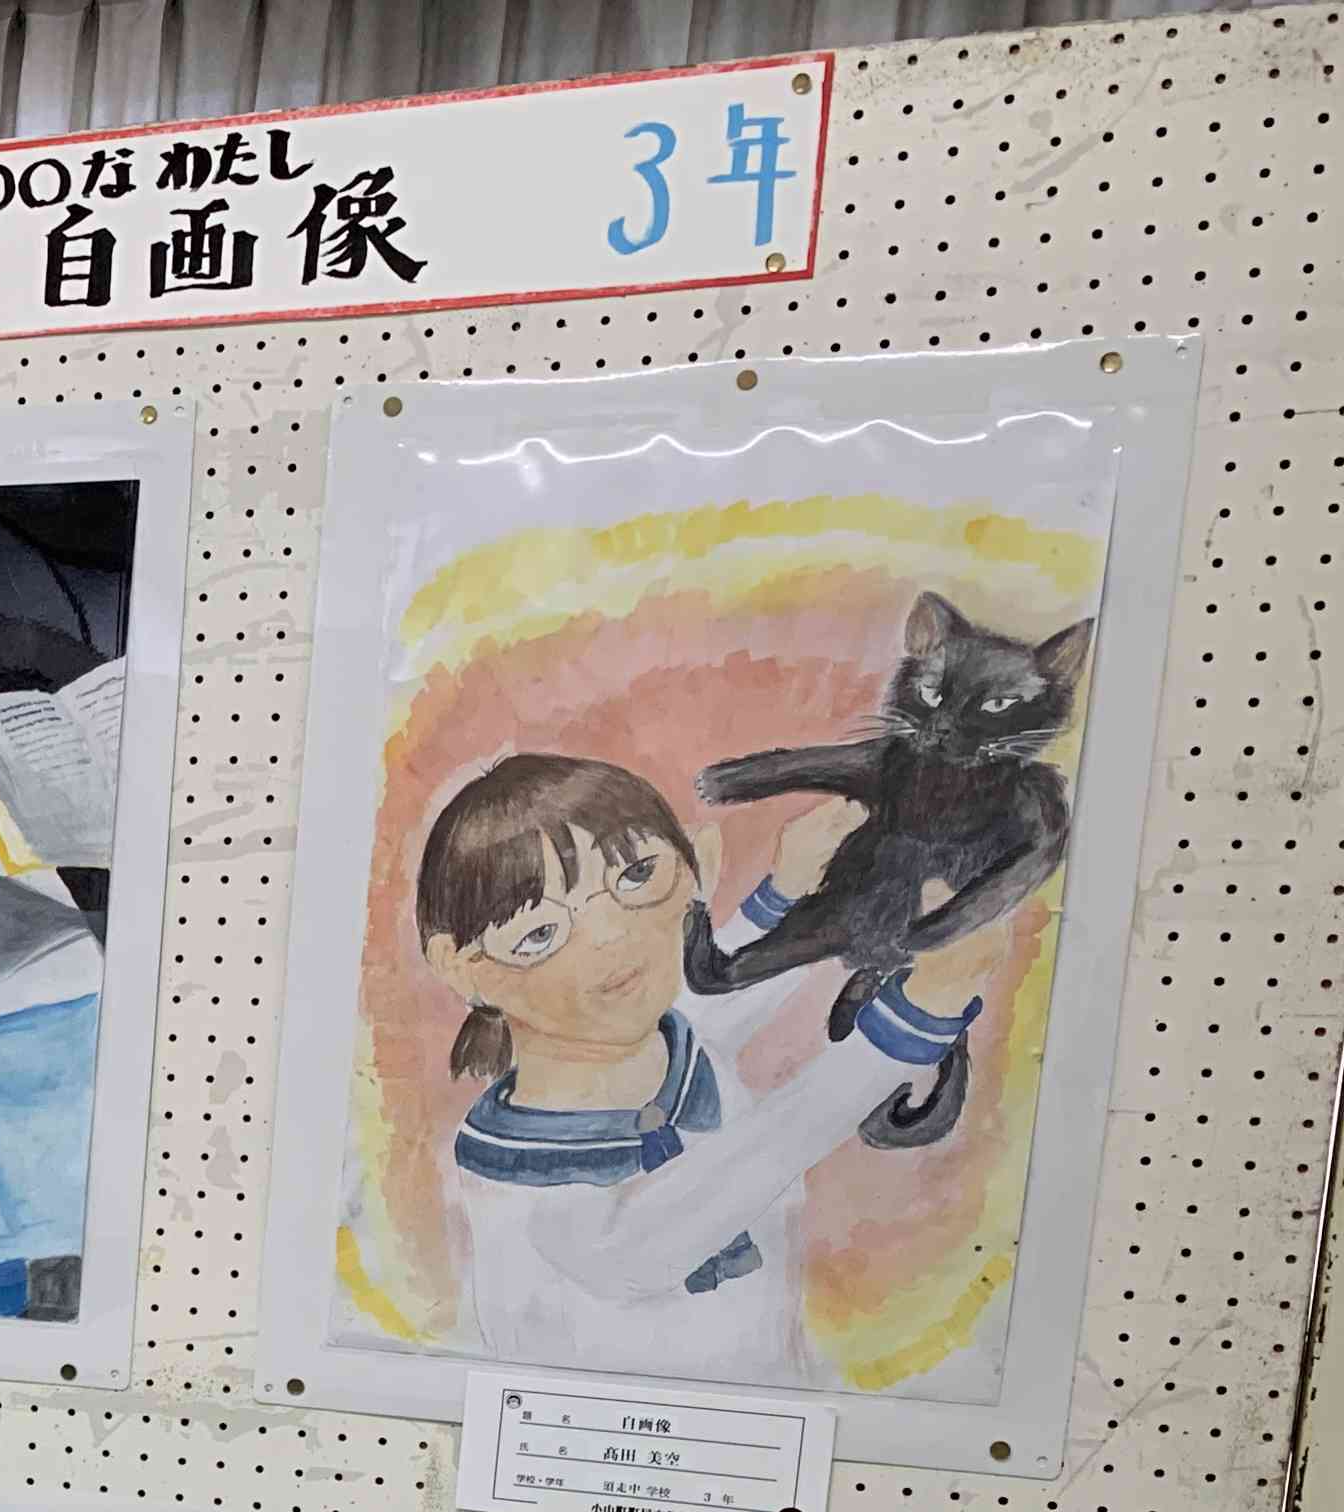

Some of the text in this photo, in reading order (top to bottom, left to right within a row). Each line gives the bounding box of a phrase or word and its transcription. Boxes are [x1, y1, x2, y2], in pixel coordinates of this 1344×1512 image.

[43, 103, 798, 307] 自画像 3年
[622, 1415, 672, 1434] 自画像
[648, 1450, 680, 1467] 美空
[646, 1485, 671, 1499] 学校
[703, 1492, 711, 1502] 3
[723, 1493, 734, 1505] 年
